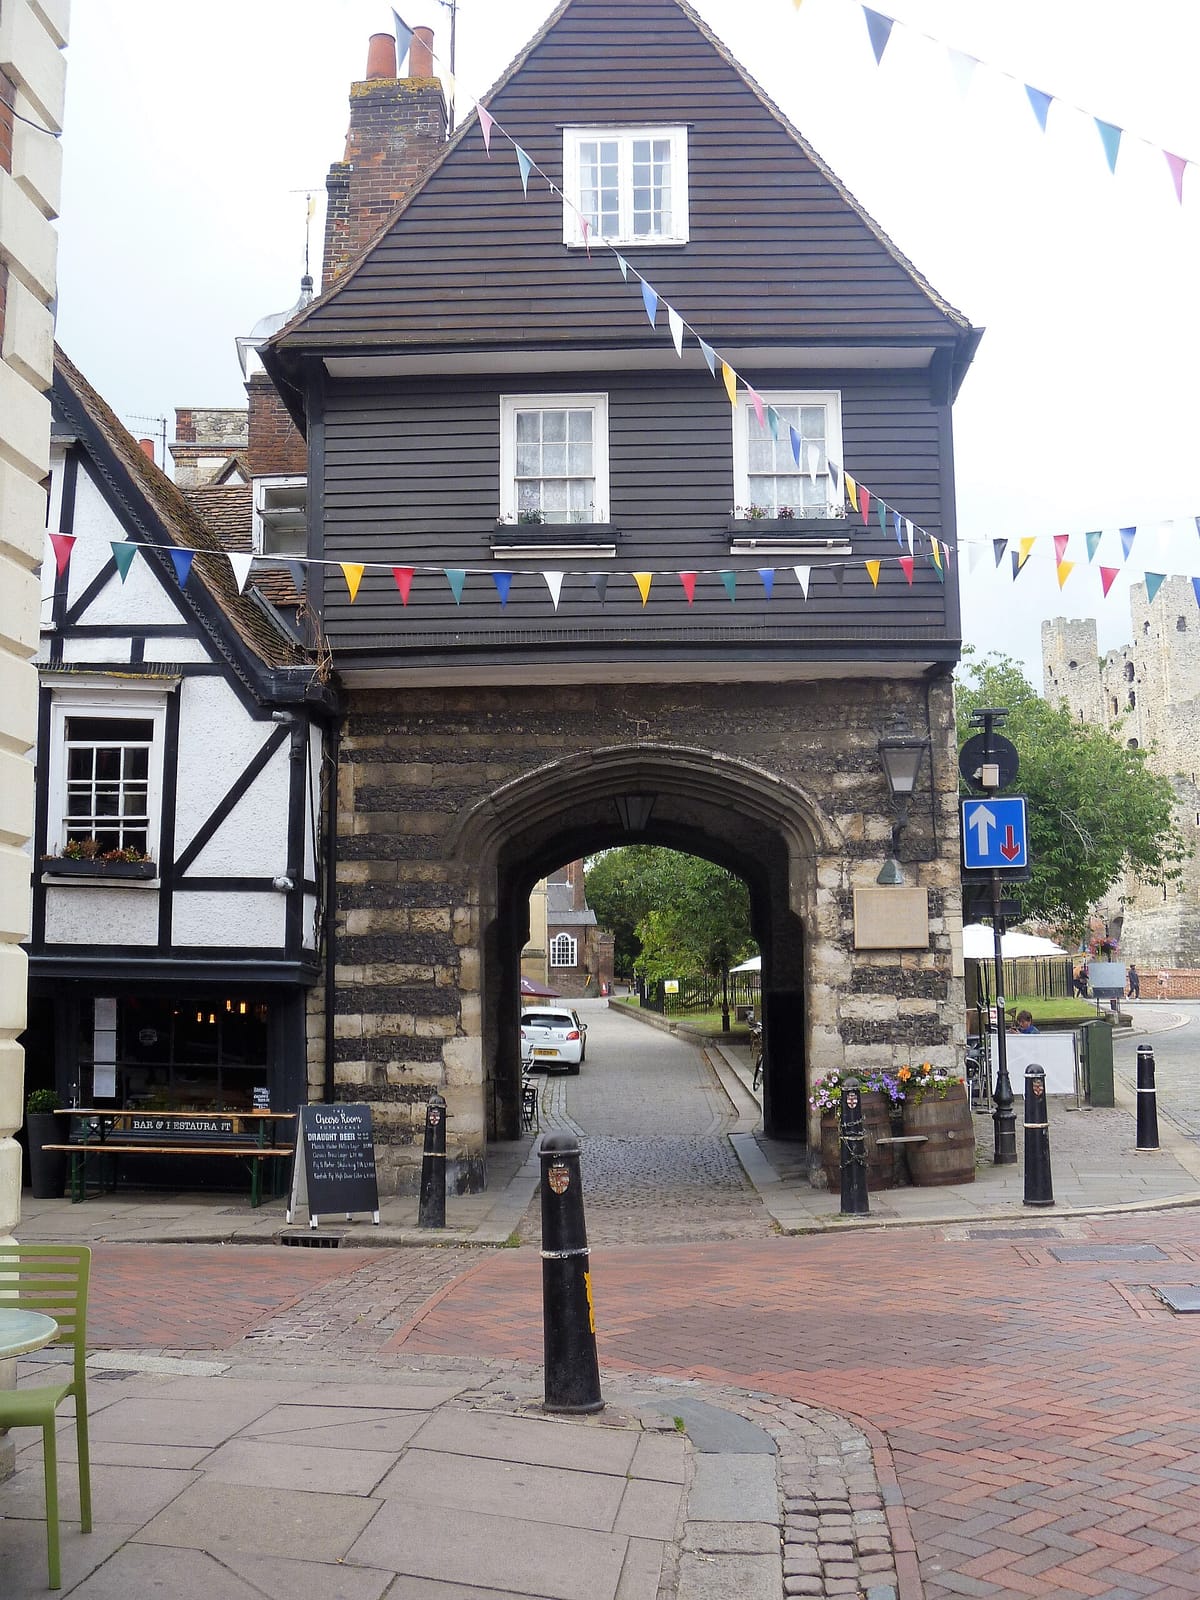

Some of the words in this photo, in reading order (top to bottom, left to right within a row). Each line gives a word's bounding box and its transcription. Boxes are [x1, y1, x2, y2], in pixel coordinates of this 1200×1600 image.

[340, 1113, 362, 1124] Room
[133, 1120, 154, 1129] BAR
[155, 1121, 164, 1130] &
[307, 1133, 337, 1141] DRAUGHT
[339, 1133, 356, 1141] BEER
